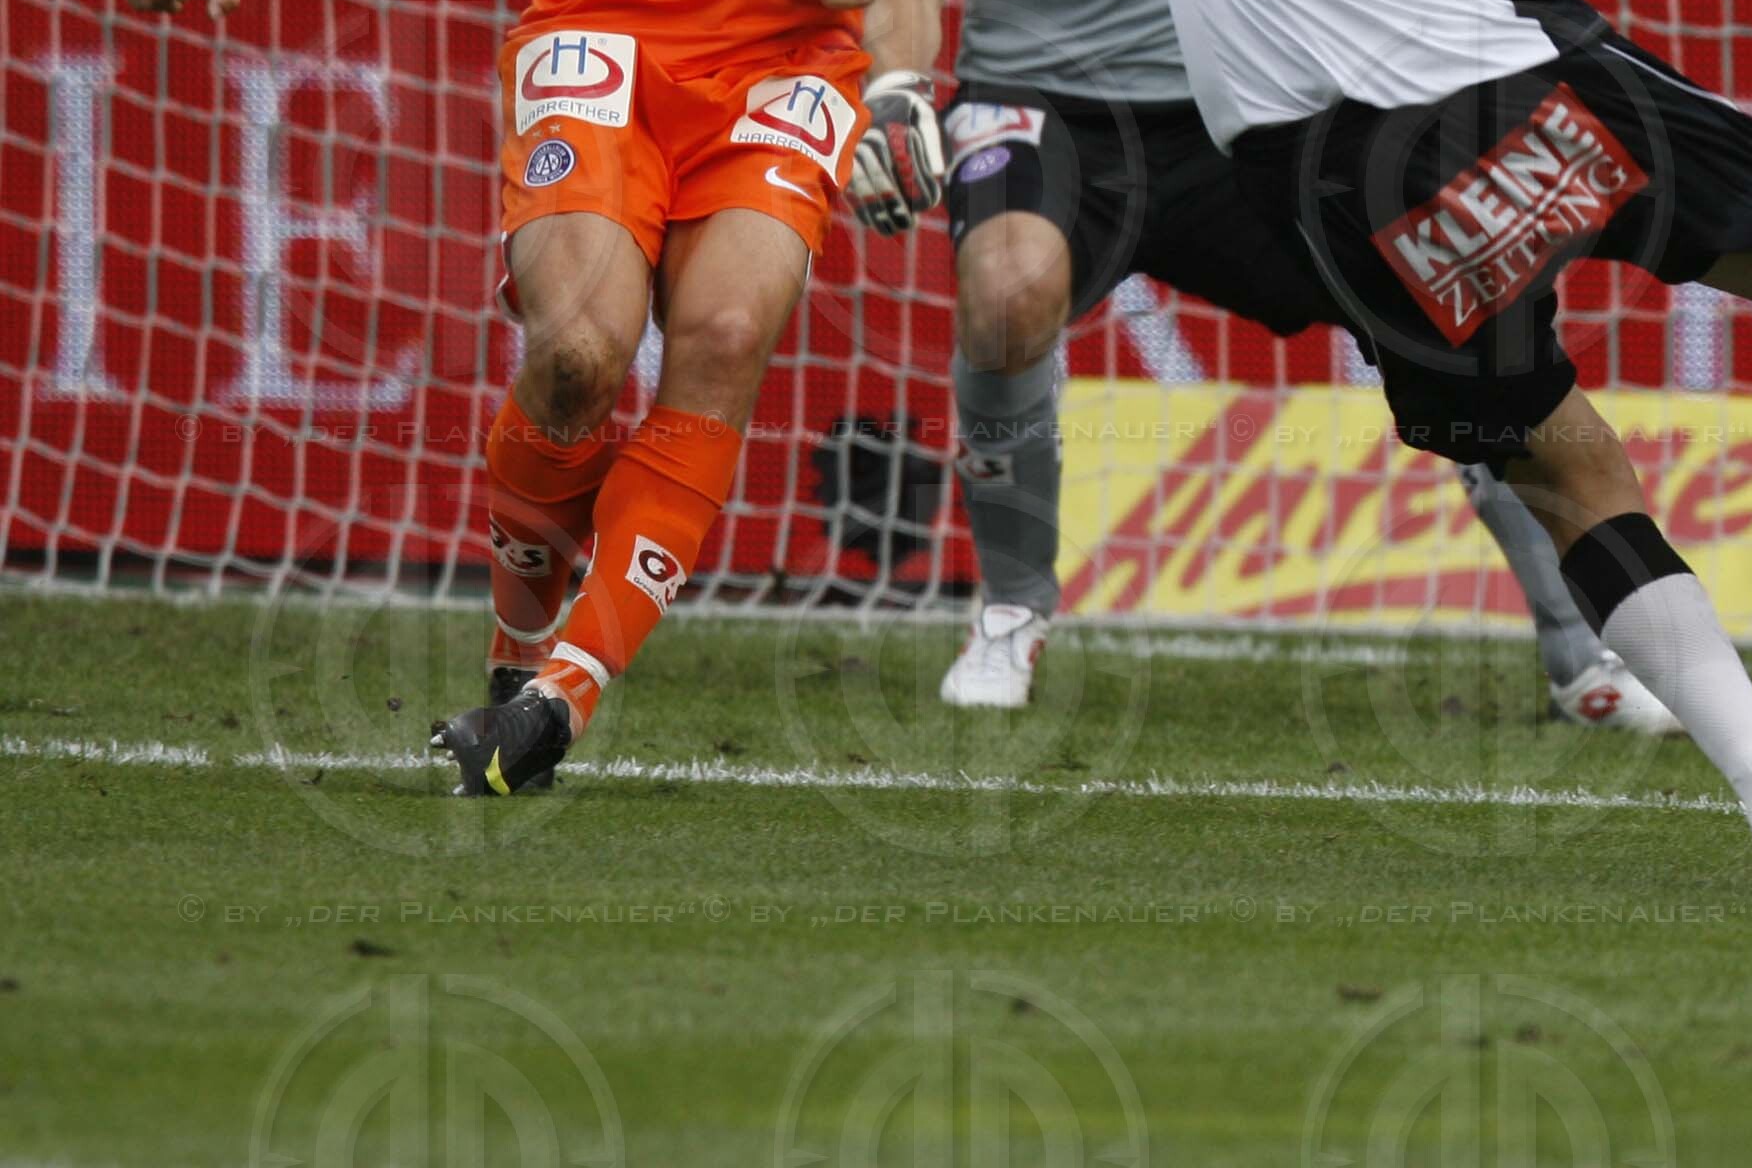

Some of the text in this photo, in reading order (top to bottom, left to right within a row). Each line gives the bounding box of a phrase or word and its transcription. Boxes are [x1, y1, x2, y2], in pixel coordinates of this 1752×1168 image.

[519, 99, 621, 131] HARREITHER
[1393, 101, 1595, 283] KLEINE
[1437, 156, 1628, 328] ZEITUNG
